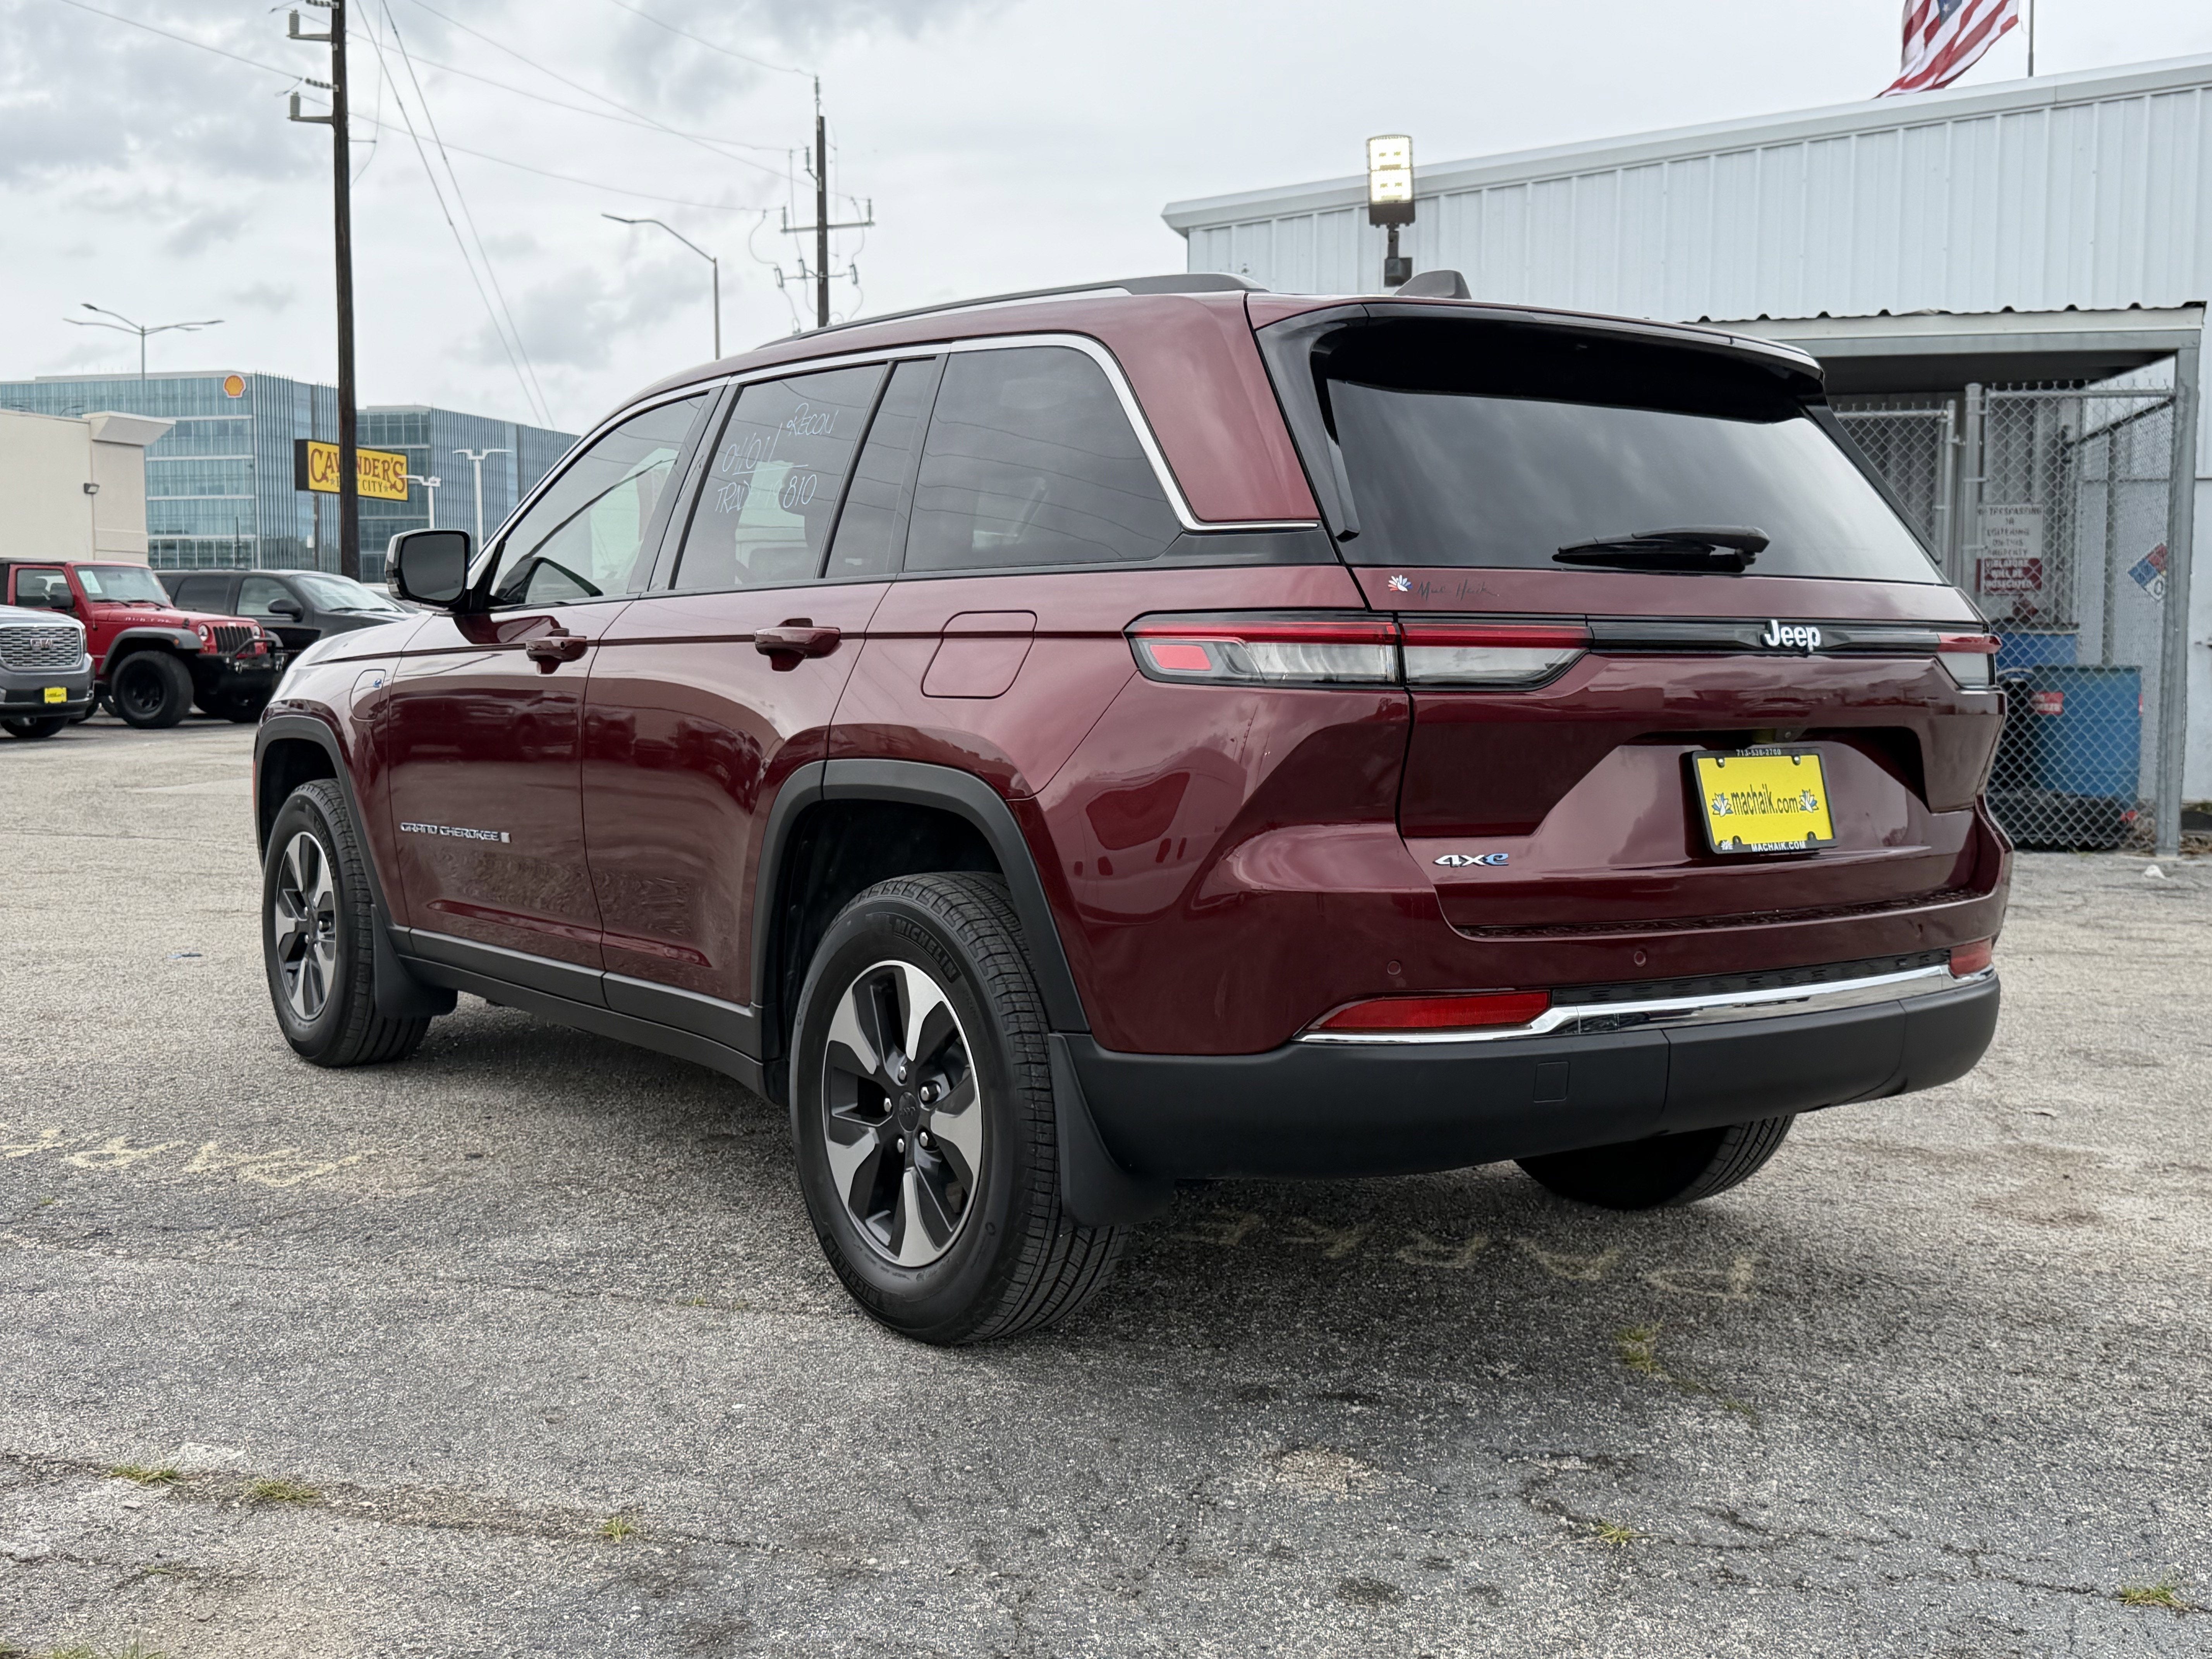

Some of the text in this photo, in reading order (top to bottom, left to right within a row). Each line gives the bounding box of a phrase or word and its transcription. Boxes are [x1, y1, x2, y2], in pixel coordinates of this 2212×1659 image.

[310, 448, 405, 493] CAVNDER'S
[362, 479, 383, 492] CITY
[1764, 619, 1821, 653] Jeep
[1730, 783, 1799, 816] machaik.com
[400, 822, 500, 842] GRAND CHEROKEE
[1751, 841, 1806, 852] MACHAIK.COM
[895, 918, 958, 981] MICHELIN
